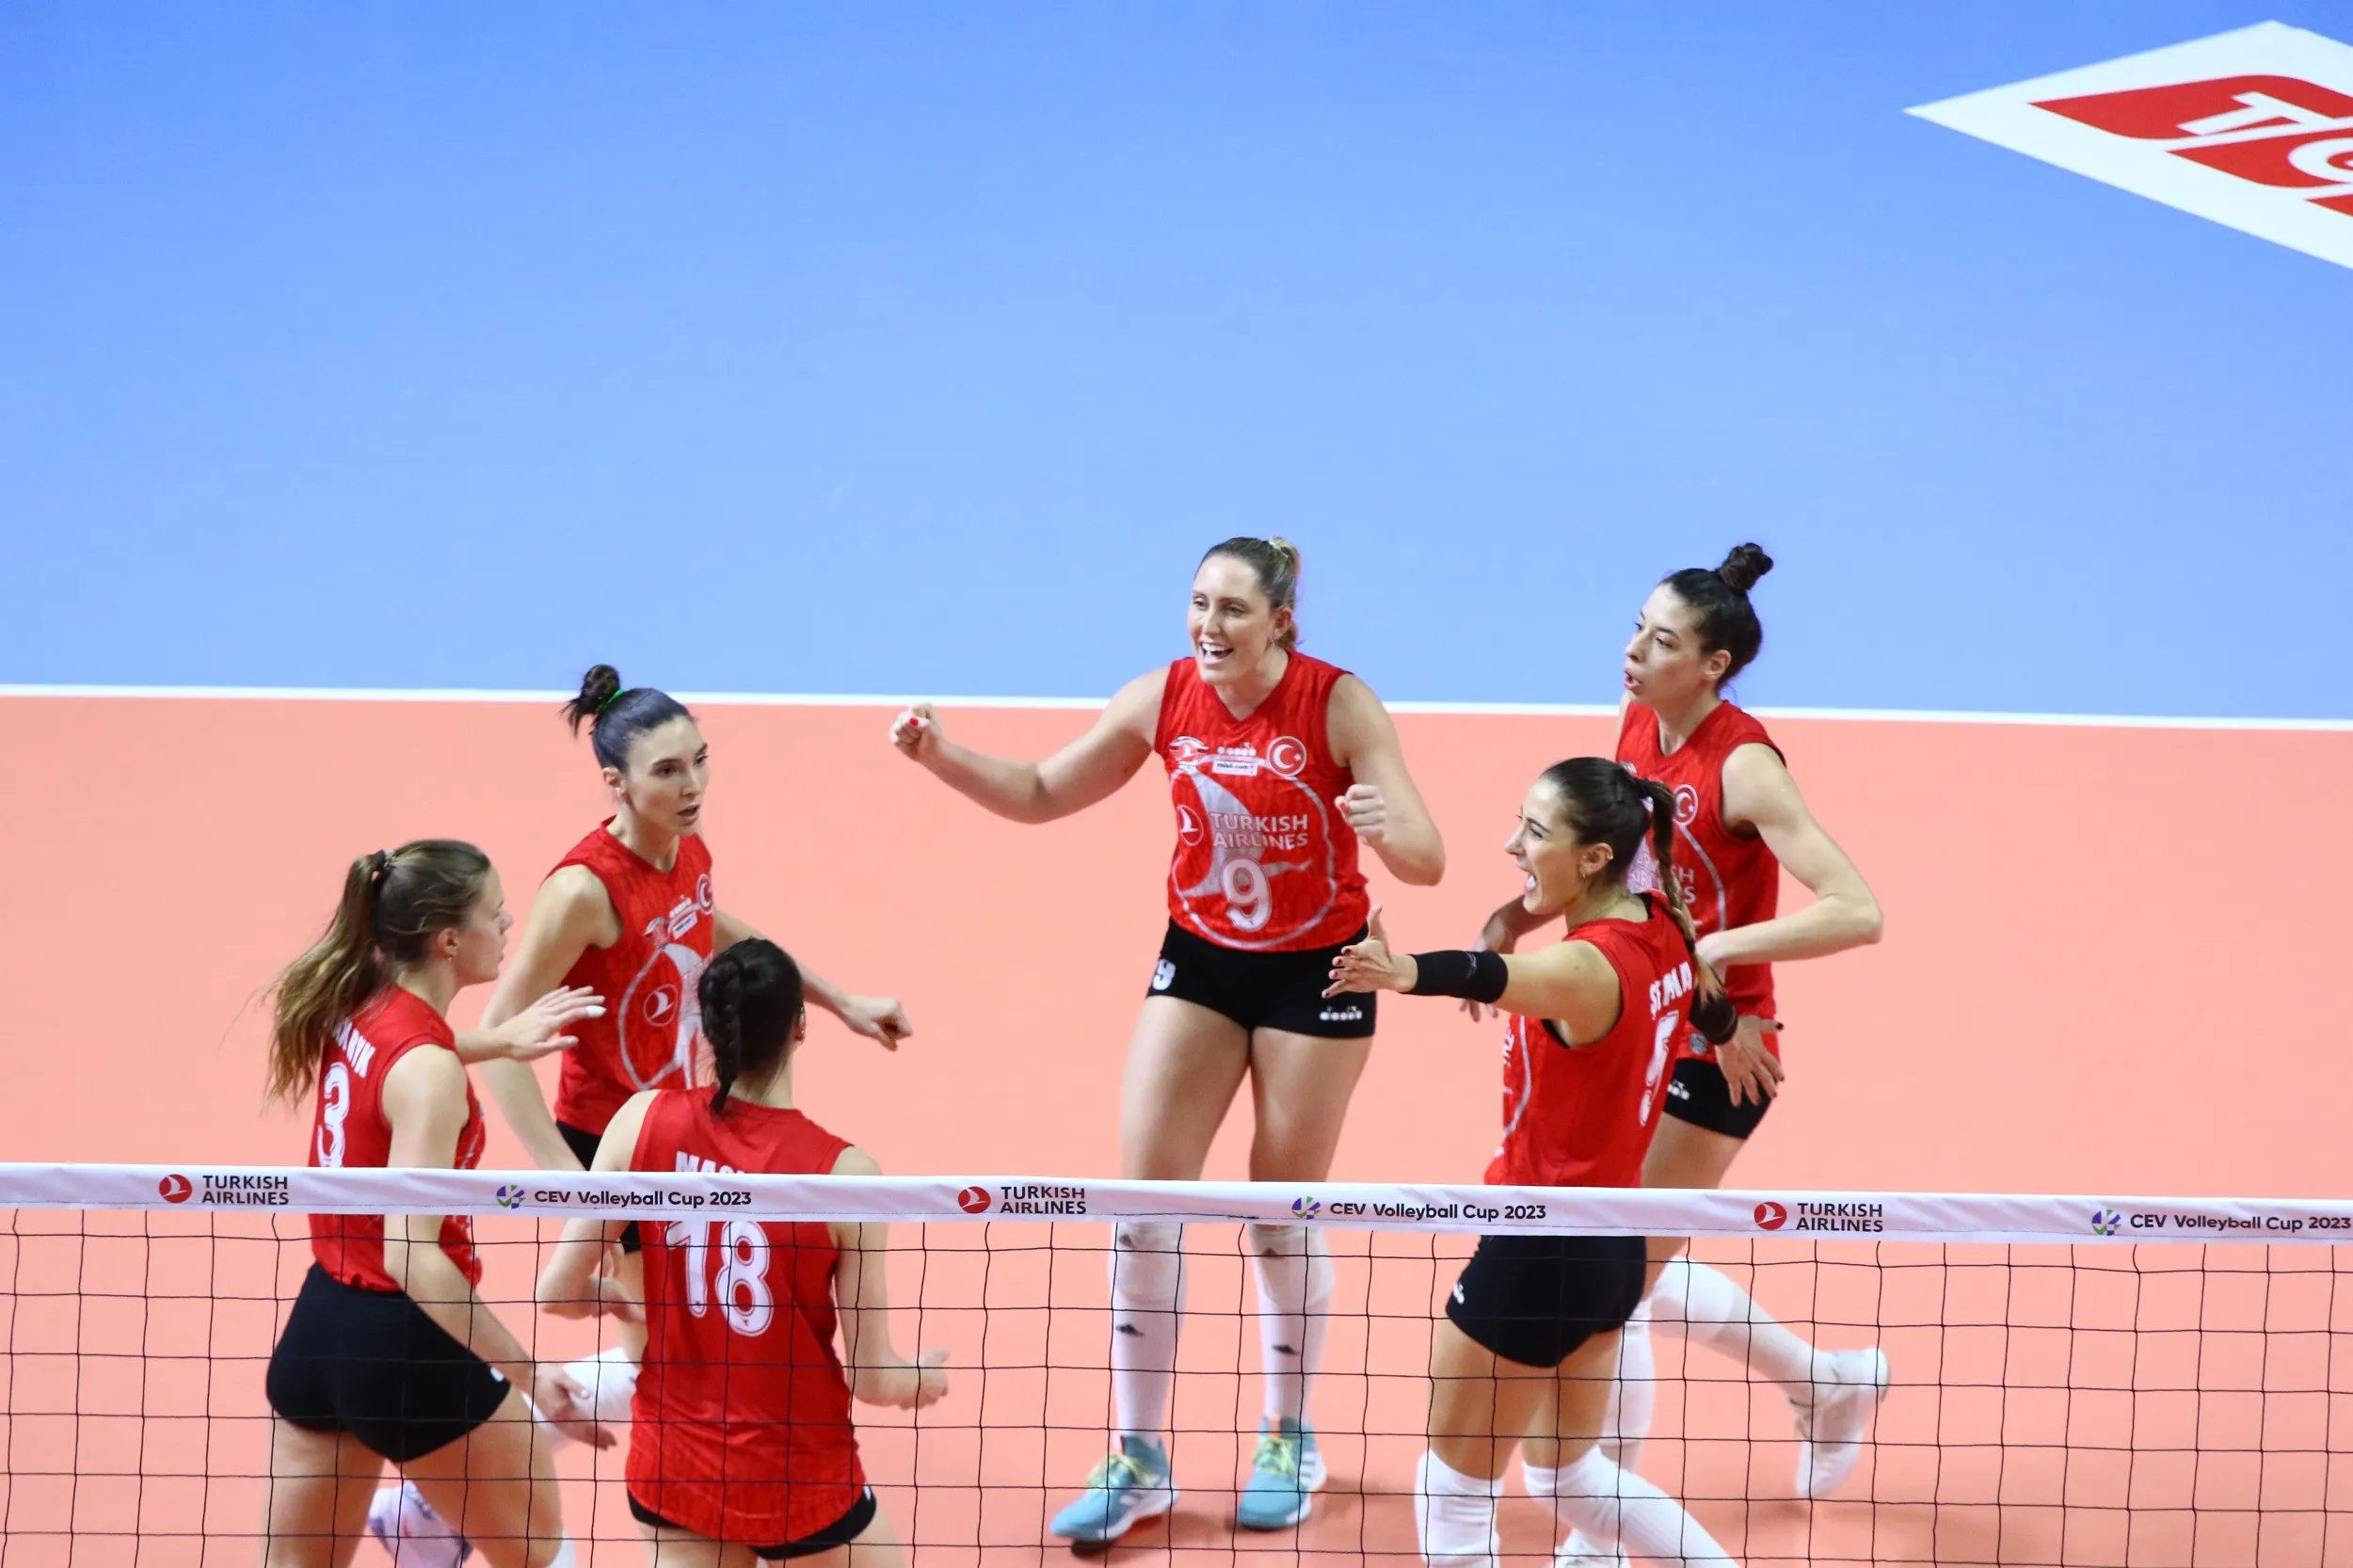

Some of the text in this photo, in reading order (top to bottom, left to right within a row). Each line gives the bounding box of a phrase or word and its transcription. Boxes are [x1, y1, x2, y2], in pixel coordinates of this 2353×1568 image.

[1209, 814, 1308, 832] TURKISH
[1213, 832, 1308, 850] AIRLINES
[1221, 856, 1273, 932] 9
[317, 1062, 350, 1167] 3
[202, 1176, 288, 1190] TURKISH
[201, 1191, 289, 1206] AIRLINES
[534, 1190, 752, 1208] CEV Volleyball Cup 2023
[1000, 1186, 1085, 1200] TURKISH
[1000, 1200, 1087, 1215] AIRLINES
[1329, 1202, 1546, 1222] CEV Volleyball Cup 2023
[1797, 1203, 1882, 1218] TURKISH
[1796, 1217, 1883, 1233] AIRLINES
[2130, 1214, 2352, 1234] CEV Volleyball Cup 2023
[664, 1221, 775, 1337] 18
